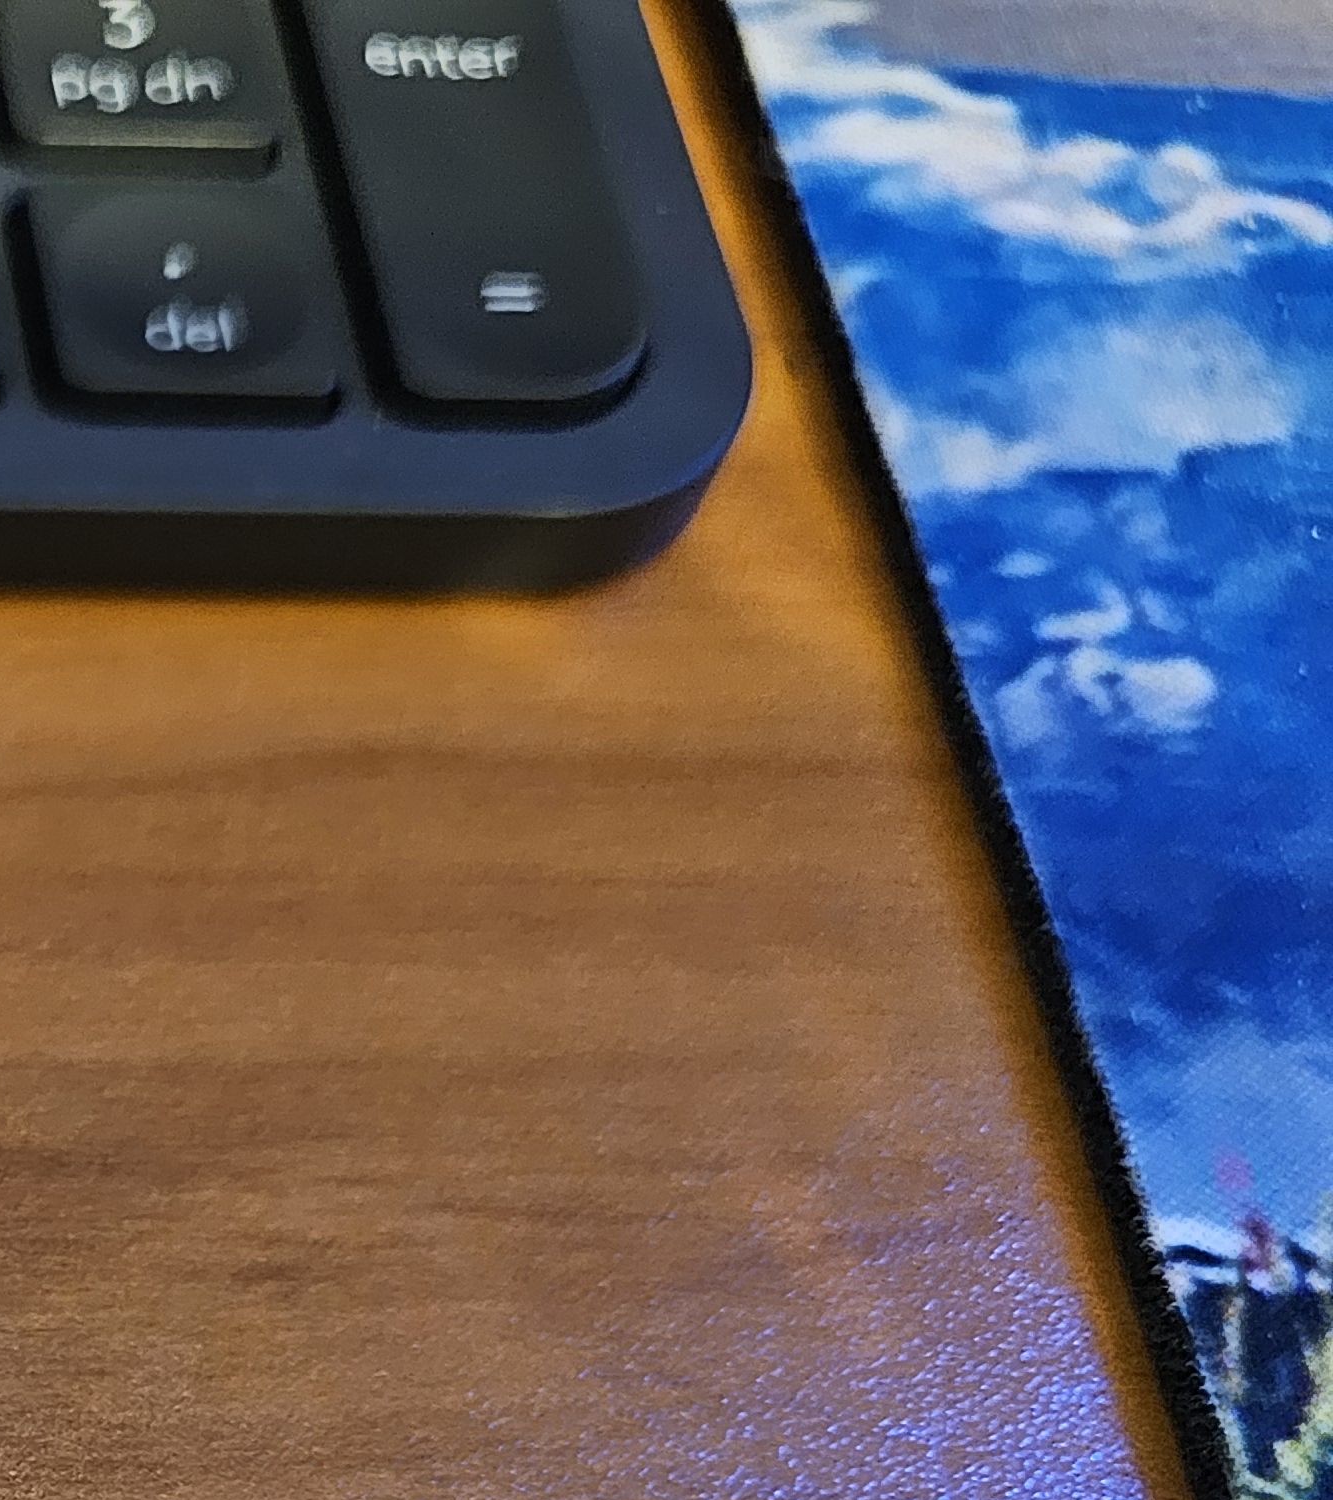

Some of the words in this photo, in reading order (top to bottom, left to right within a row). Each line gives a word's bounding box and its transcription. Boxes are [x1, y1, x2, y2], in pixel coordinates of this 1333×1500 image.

[51, 52, 139, 113] pg
[145, 52, 233, 105] dn
[364, 31, 521, 80] enter
[145, 296, 248, 353] del
